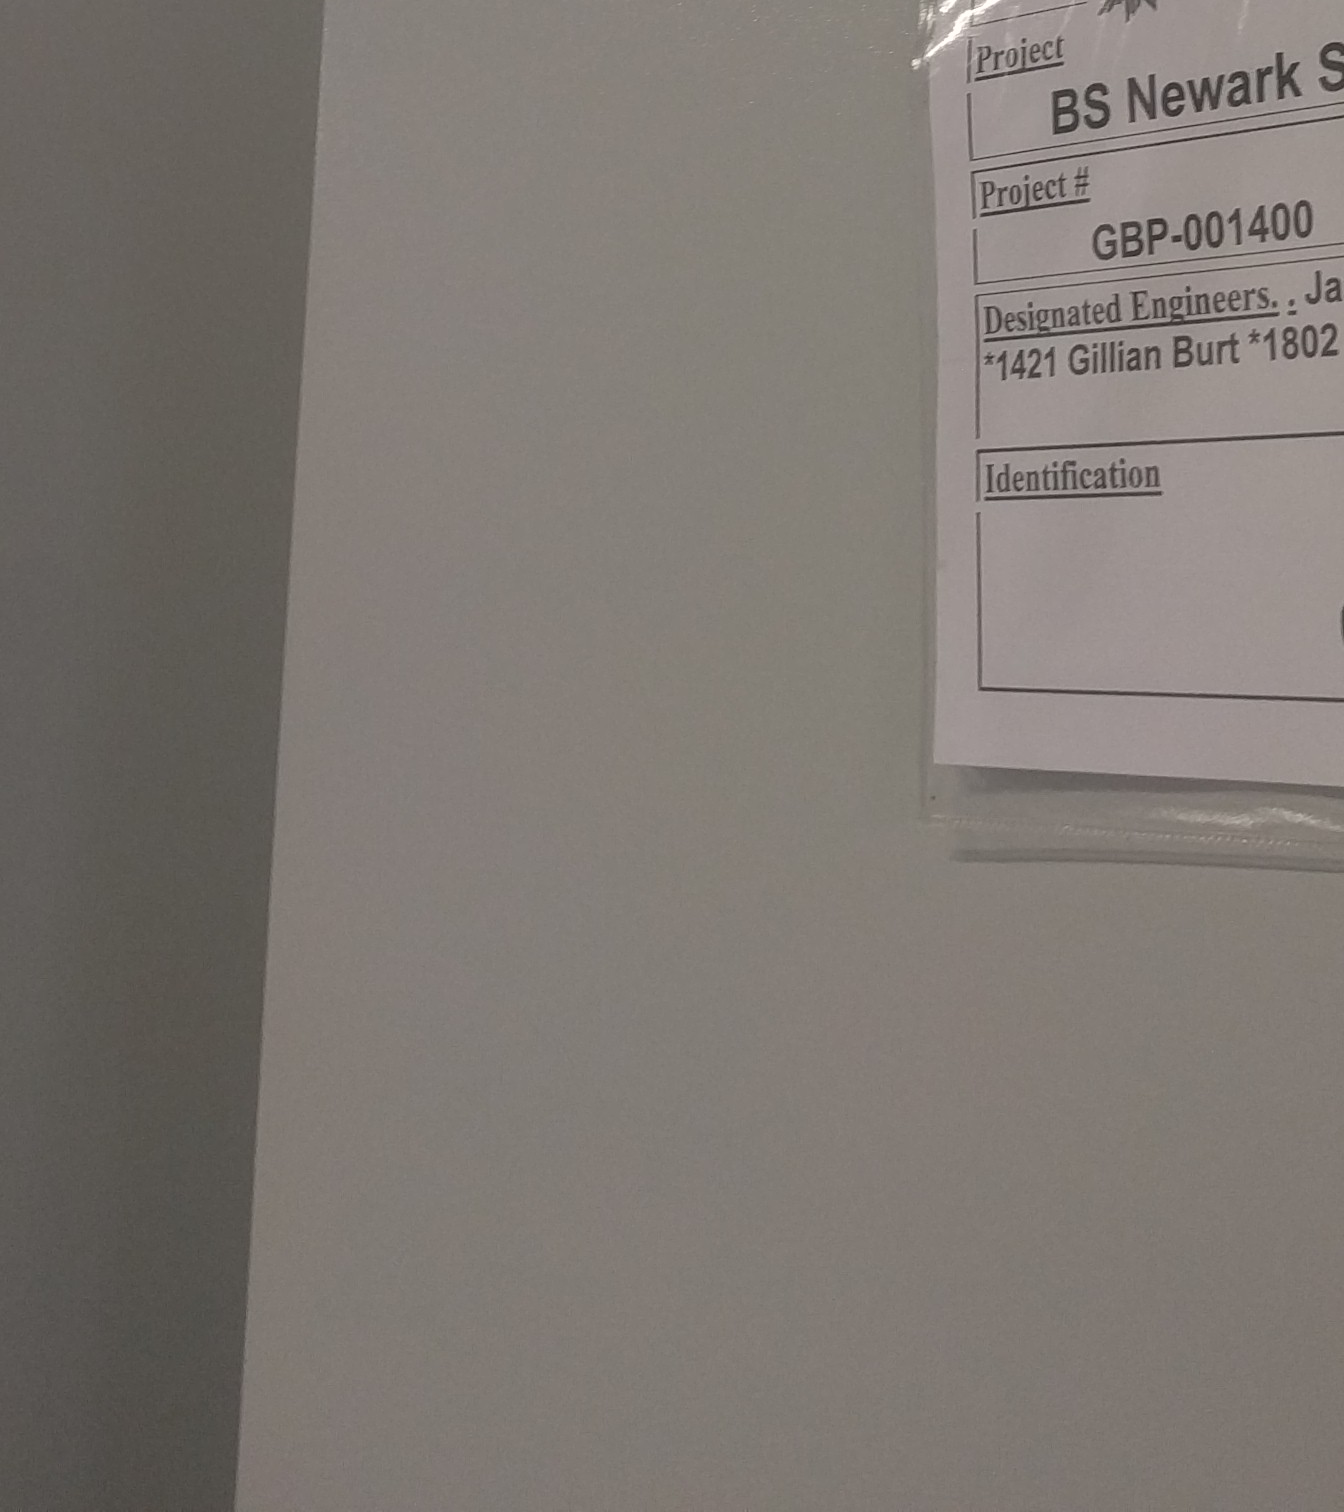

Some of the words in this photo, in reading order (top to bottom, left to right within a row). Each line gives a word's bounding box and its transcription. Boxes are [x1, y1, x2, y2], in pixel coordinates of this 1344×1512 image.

[975, 35, 1065, 78] Project
[1051, 84, 1112, 136] BS
[1127, 52, 1302, 124] Newark
[979, 174, 1069, 212] Project
[1074, 167, 1090, 197] #
[1091, 200, 1314, 261] GBP-001400
[983, 293, 1122, 336] Designated
[1067, 339, 1162, 376] Gillian
[1172, 332, 1240, 369] Burt
[983, 457, 1162, 496] Identification
